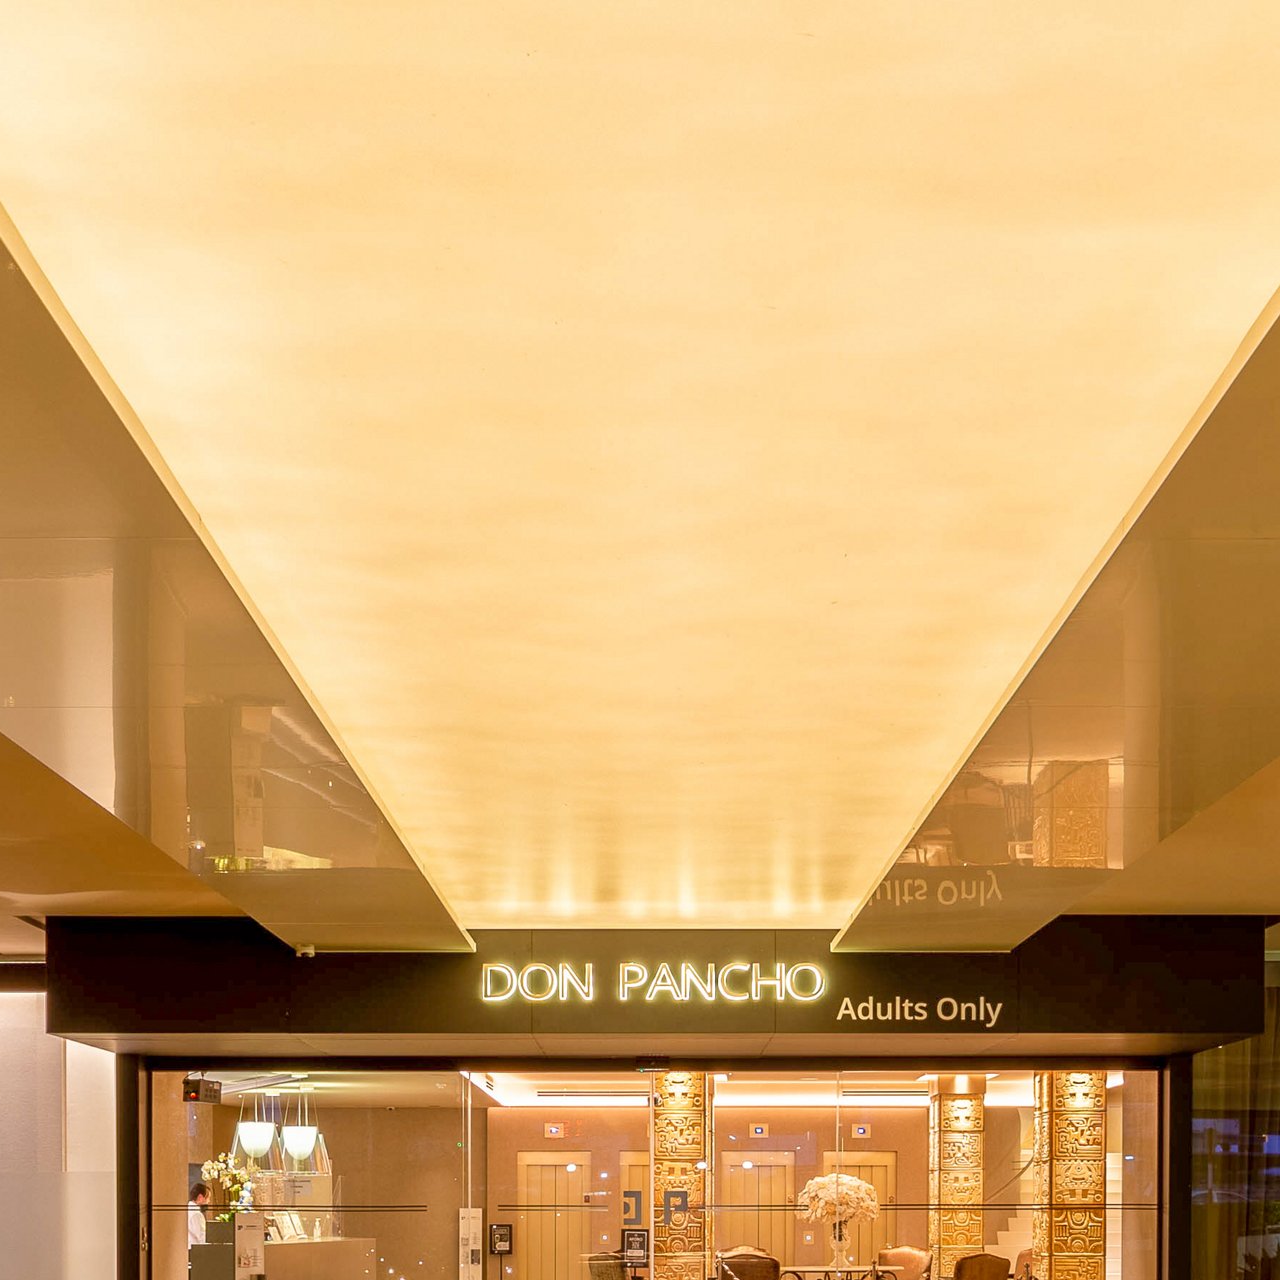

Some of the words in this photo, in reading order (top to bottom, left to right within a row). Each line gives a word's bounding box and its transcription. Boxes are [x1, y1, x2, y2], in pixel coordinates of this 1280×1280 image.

[482, 962, 594, 1001] DON
[619, 962, 826, 1001] PANCHO
[836, 996, 928, 1021] Adults
[936, 996, 1003, 1028] Only
